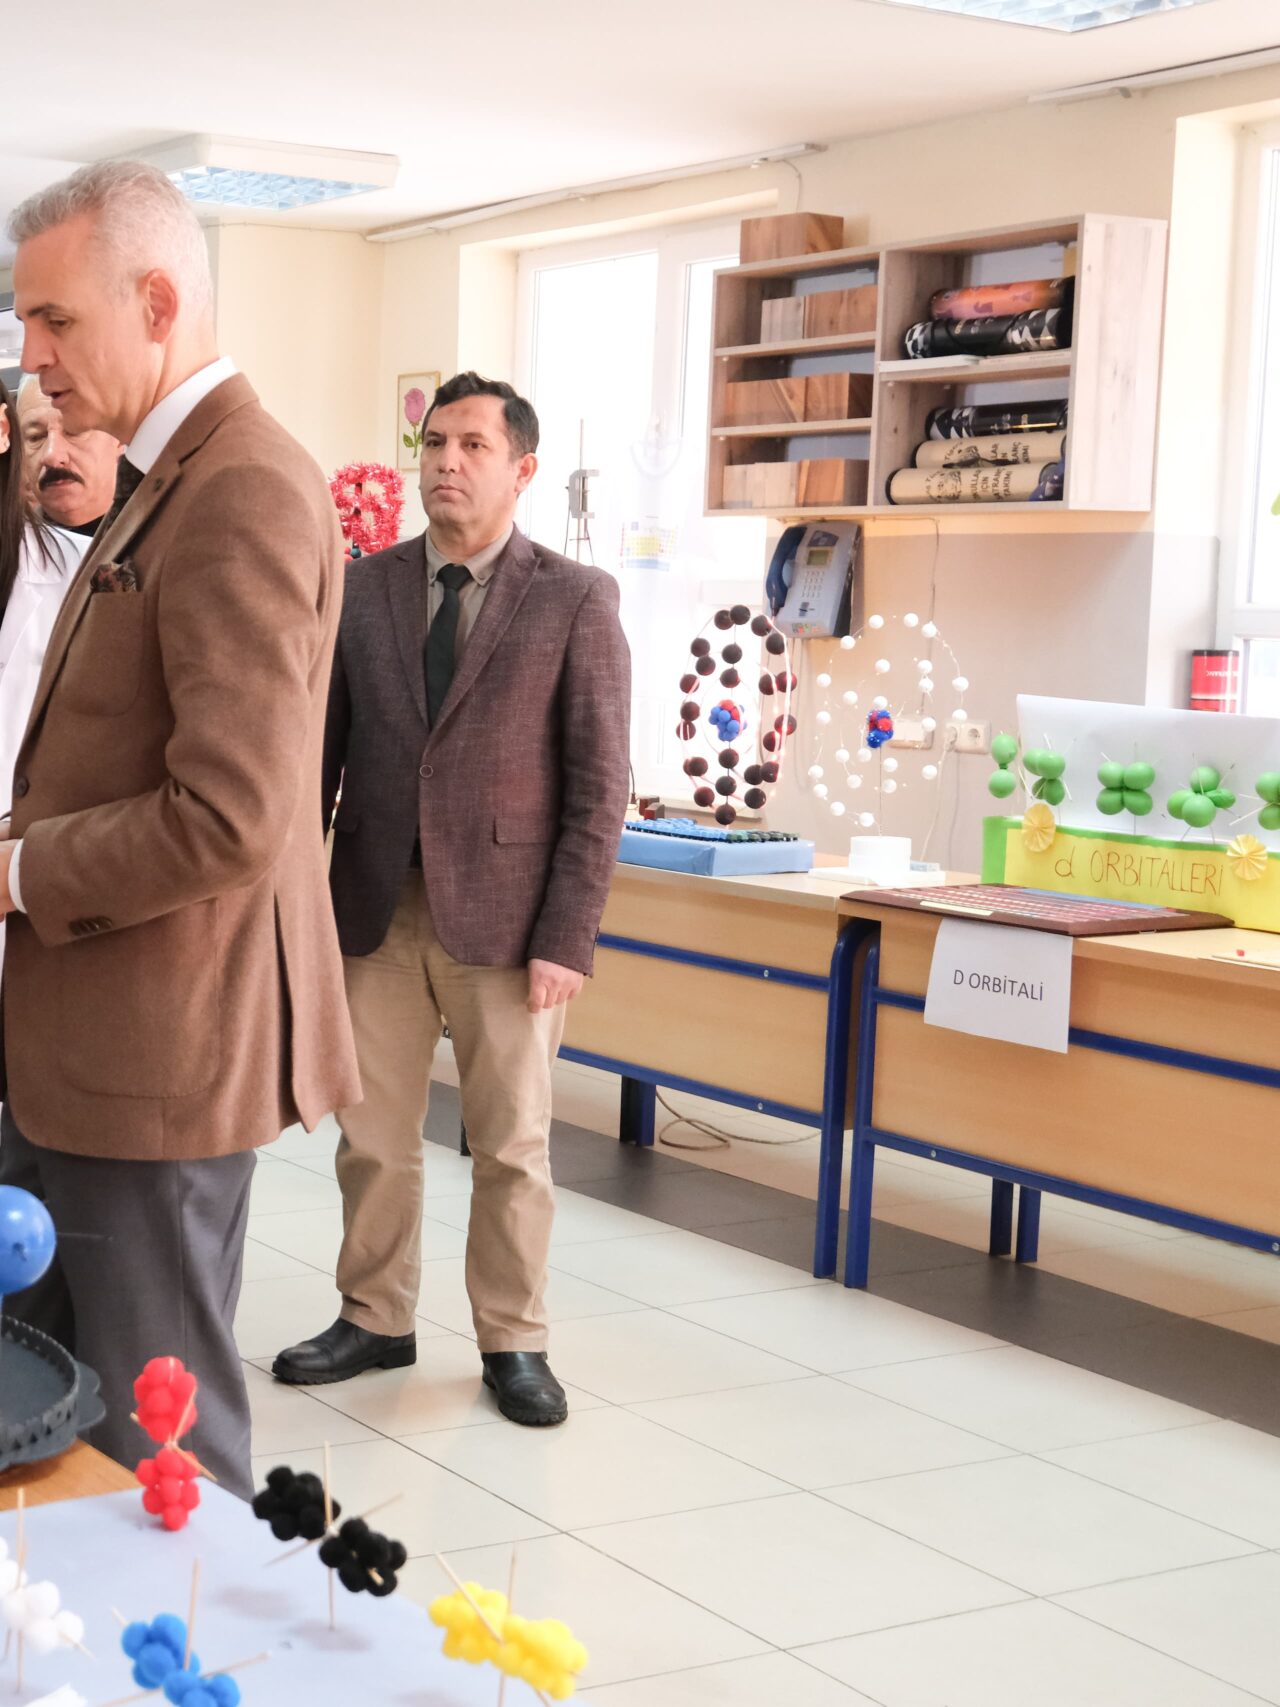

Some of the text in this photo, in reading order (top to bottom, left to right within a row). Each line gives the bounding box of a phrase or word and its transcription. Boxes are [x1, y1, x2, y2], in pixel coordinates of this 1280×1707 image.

[1054, 845, 1076, 879] d
[953, 969, 1044, 1001] D ORBİTALİ
